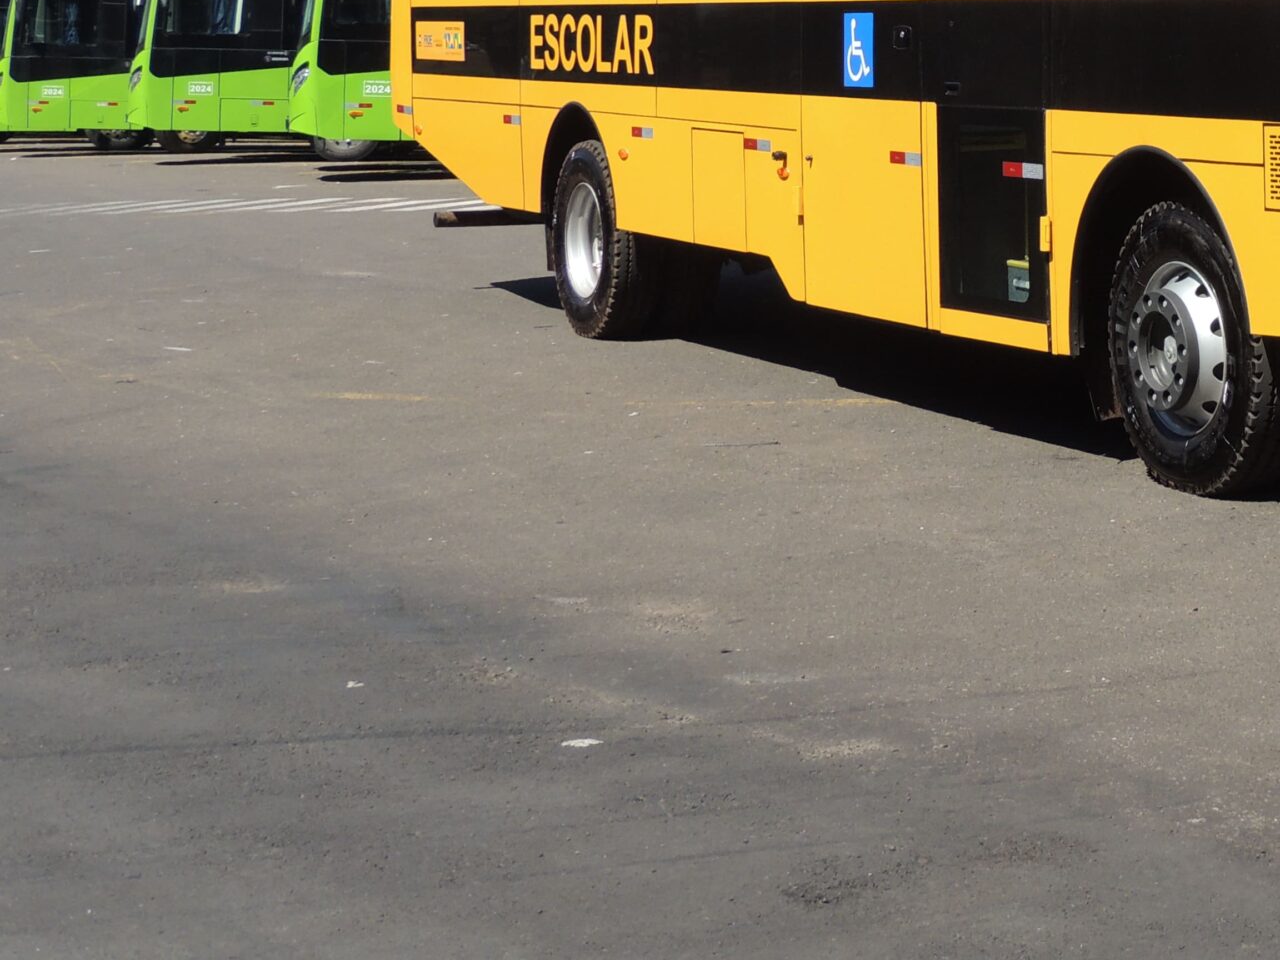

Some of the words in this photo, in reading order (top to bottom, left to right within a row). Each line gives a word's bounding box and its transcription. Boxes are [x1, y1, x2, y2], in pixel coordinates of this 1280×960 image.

[529, 13, 655, 75] ESCOLAR
[43, 88, 63, 96] 2024
[189, 84, 212, 93] 2024
[365, 84, 391, 94] 2024
